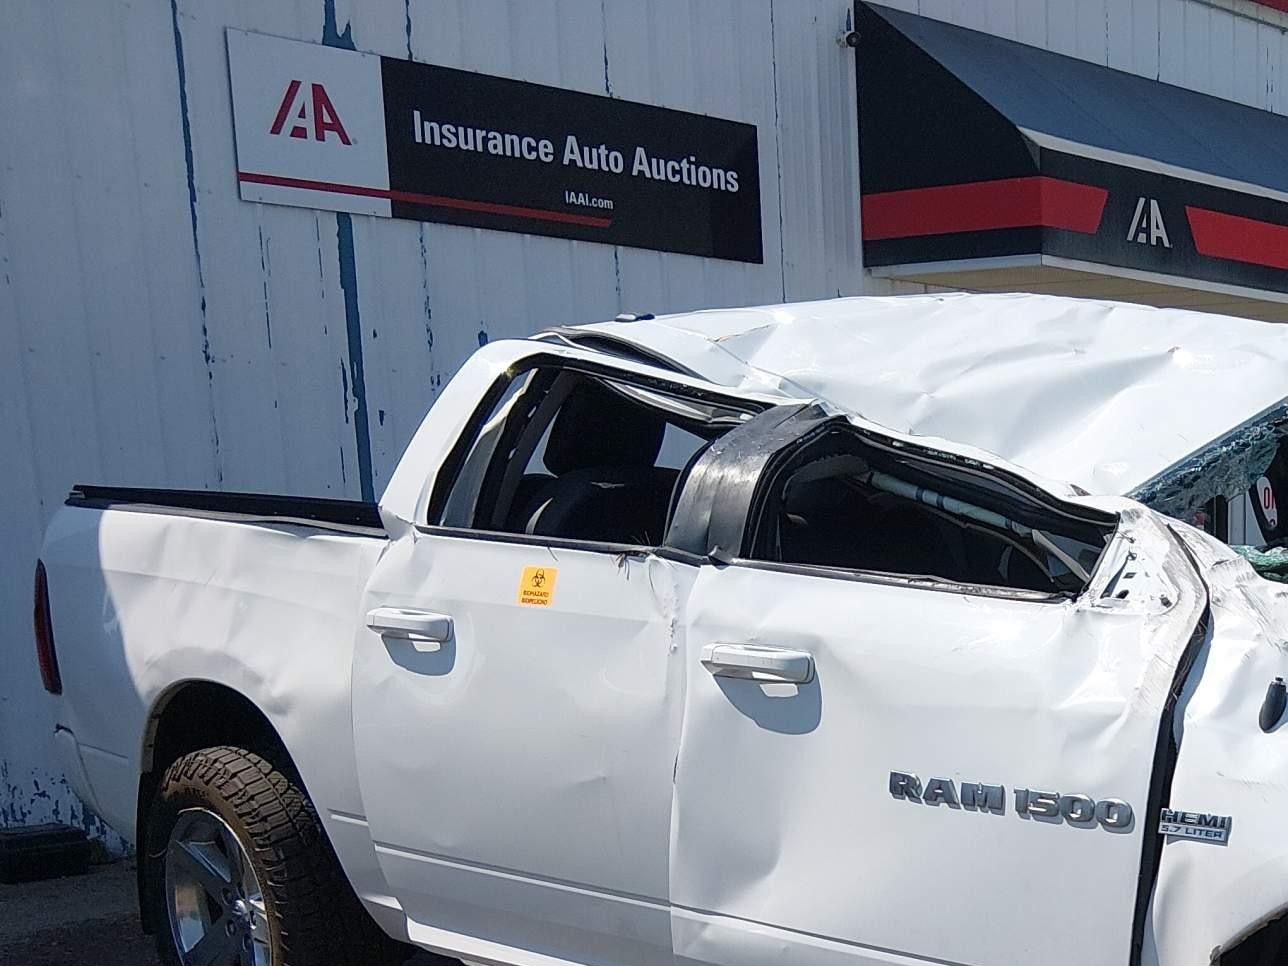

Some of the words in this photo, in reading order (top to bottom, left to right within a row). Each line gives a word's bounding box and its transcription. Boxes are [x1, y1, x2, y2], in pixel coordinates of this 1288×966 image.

[413, 110, 554, 162] Insurance
[562, 135, 624, 174] Auto
[631, 146, 739, 193] Auctions
[565, 190, 614, 210] IAAI.com
[889, 770, 1005, 812] RAM
[1013, 786, 1134, 829] 1500
[1160, 808, 1229, 829] HEMI
[1185, 827, 1222, 838] LITER
